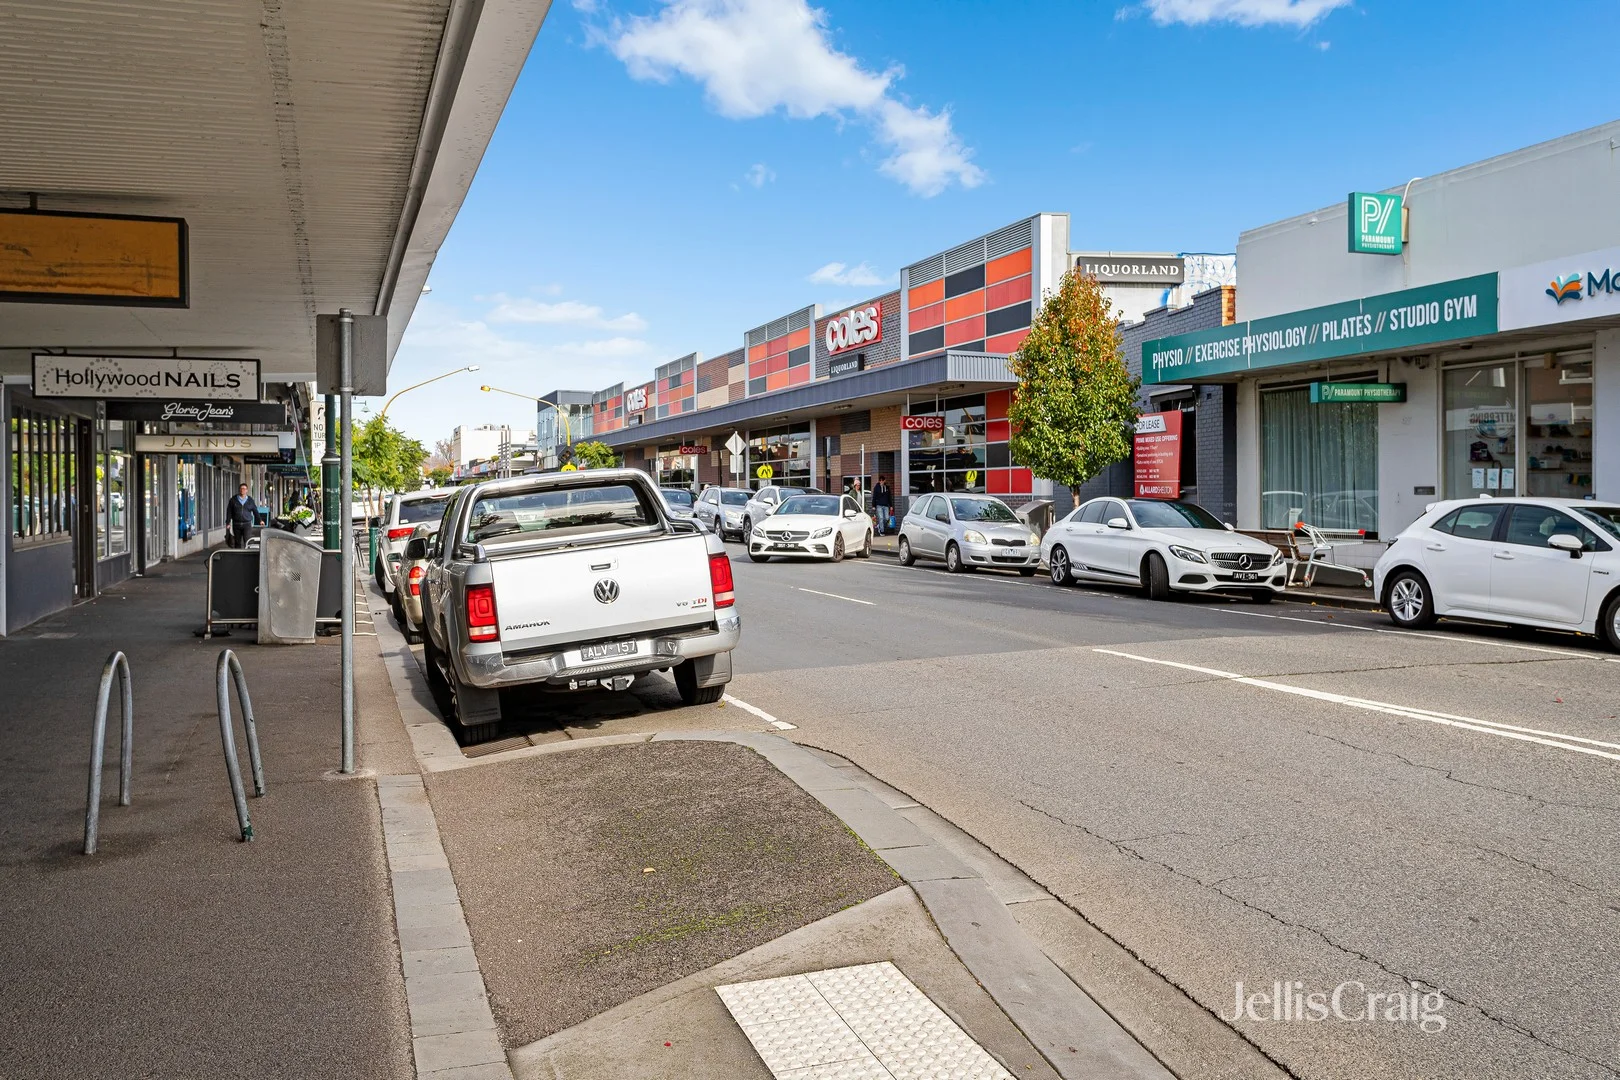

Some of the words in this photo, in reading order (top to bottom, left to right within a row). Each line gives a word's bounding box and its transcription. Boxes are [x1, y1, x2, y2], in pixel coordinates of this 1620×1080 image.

[1361, 234, 1395, 244] PARAMOUNT
[1361, 242, 1395, 250] PHYSIOTHERAPY
[1085, 263, 1180, 277] LIQUORLAND
[826, 307, 878, 351] coles
[1152, 347, 1183, 370] PHYSIO
[1195, 337, 1240, 363] EXERCISE
[1242, 326, 1307, 355] PHYSIOLOGY
[1322, 314, 1372, 342] PILATES
[1389, 301, 1440, 331] STUDIO
[1443, 294, 1478, 322] GYM
[830, 360, 858, 374] LIQUORLAND
[56, 368, 161, 389] Hollywood
[164, 372, 241, 388] NAILS
[1334, 388, 1363, 397] PARAMOUNT
[1363, 388, 1401, 397] PHYSIOTHERAPY
[161, 402, 199, 420] Gloria
[197, 403, 233, 421] Jean's
[313, 423, 324, 431] NO
[905, 416, 943, 428] coles
[1146, 419, 1160, 429] LEASE
[164, 436, 252, 449] JAINUS
[682, 446, 706, 454] coles
